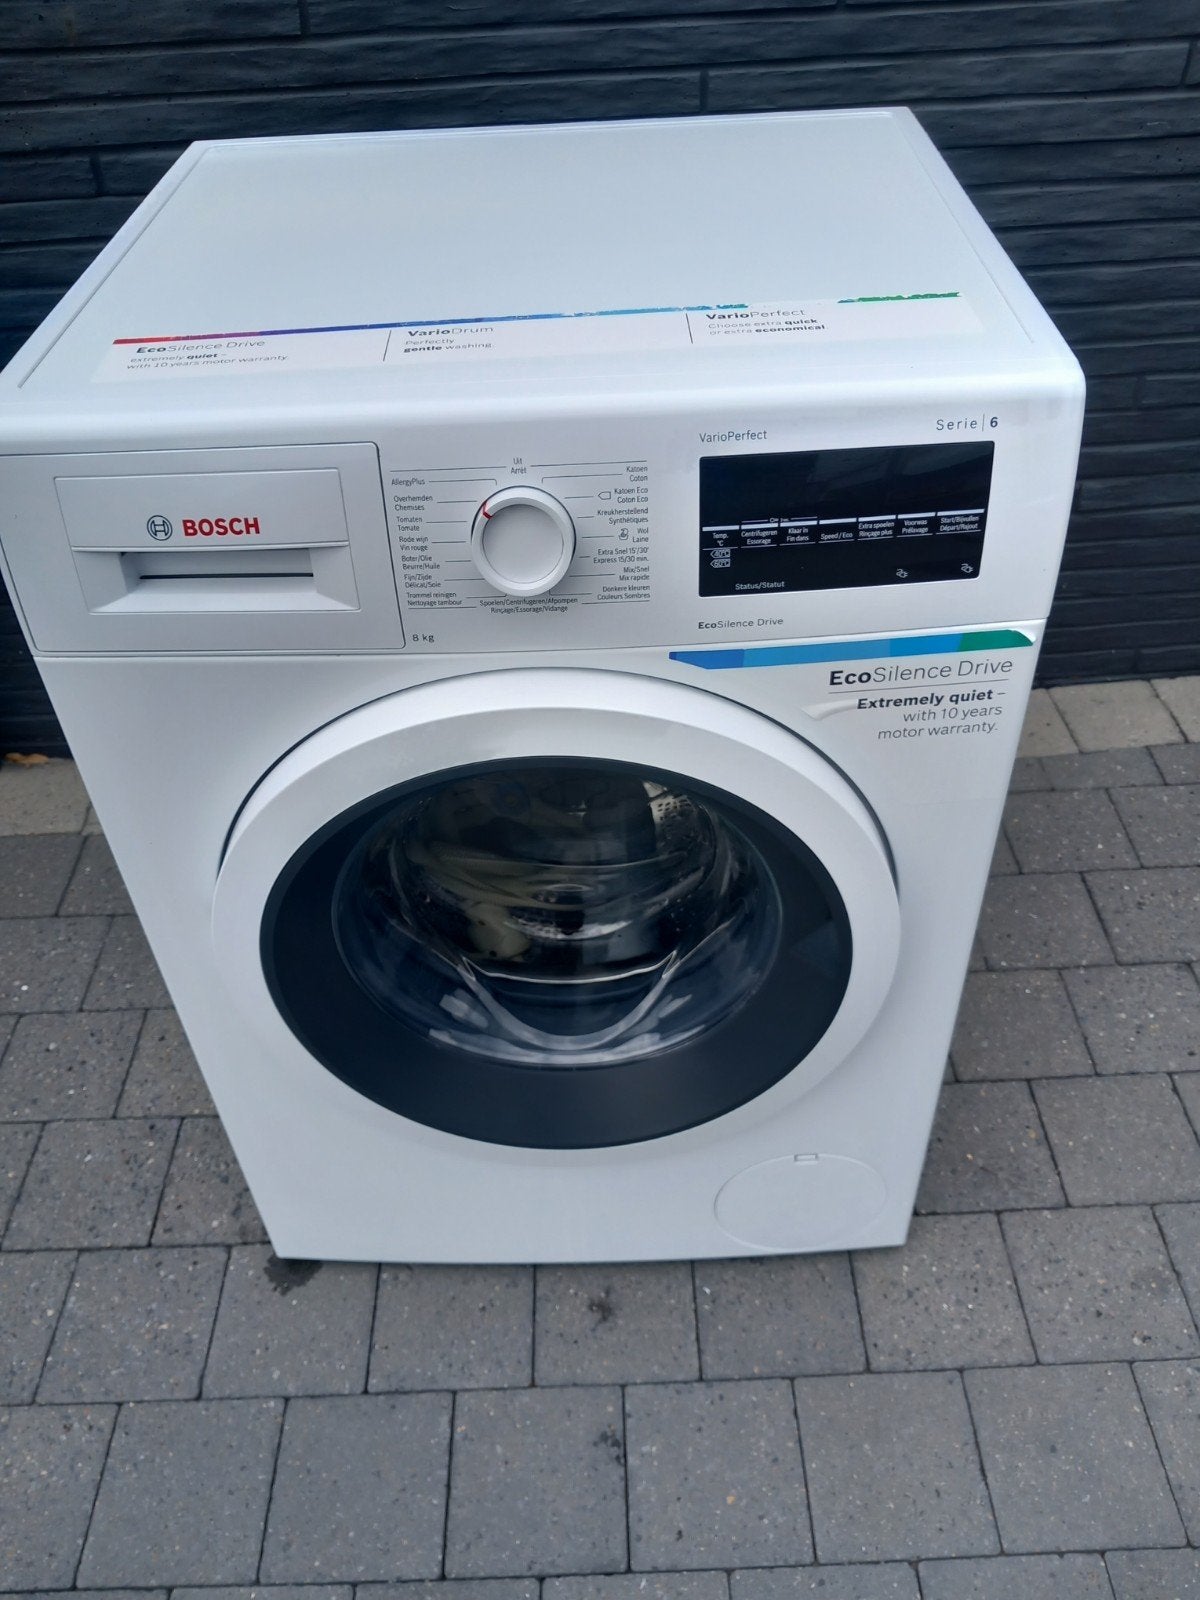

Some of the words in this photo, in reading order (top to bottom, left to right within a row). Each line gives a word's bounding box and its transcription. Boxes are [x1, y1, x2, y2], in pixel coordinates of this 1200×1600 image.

[706, 310, 806, 320] VarioPerfect
[408, 328, 494, 336] VarioDrum
[136, 344, 222, 354] EcoSilence
[226, 340, 265, 348] Drive
[130, 354, 185, 362] extremely
[936, 418, 978, 431] Serie
[990, 416, 998, 428] 6
[699, 430, 768, 443] VarioPerfect
[392, 478, 425, 486] AllergyPlus
[597, 508, 648, 516] Kreukherstellend
[182, 517, 260, 536] BOSCH
[741, 530, 778, 538] Centrifugeren
[736, 582, 785, 590] Status/Statut
[480, 598, 578, 608] Spoelen/Centrifugeren/Afpompen
[490, 606, 568, 614] Rinçage/Essorage/Vidange
[698, 619, 754, 630] EcoSilence
[757, 618, 784, 626] Drive
[422, 634, 434, 642] kg
[829, 662, 952, 686] EcoSilence
[958, 658, 1014, 677] Drive
[857, 692, 944, 710] Extremely
[949, 689, 994, 704] quiet
[903, 708, 936, 722] with
[942, 707, 958, 719] 10
[961, 706, 1002, 720] years
[878, 726, 925, 740] motor
[928, 721, 998, 737] warranty.
